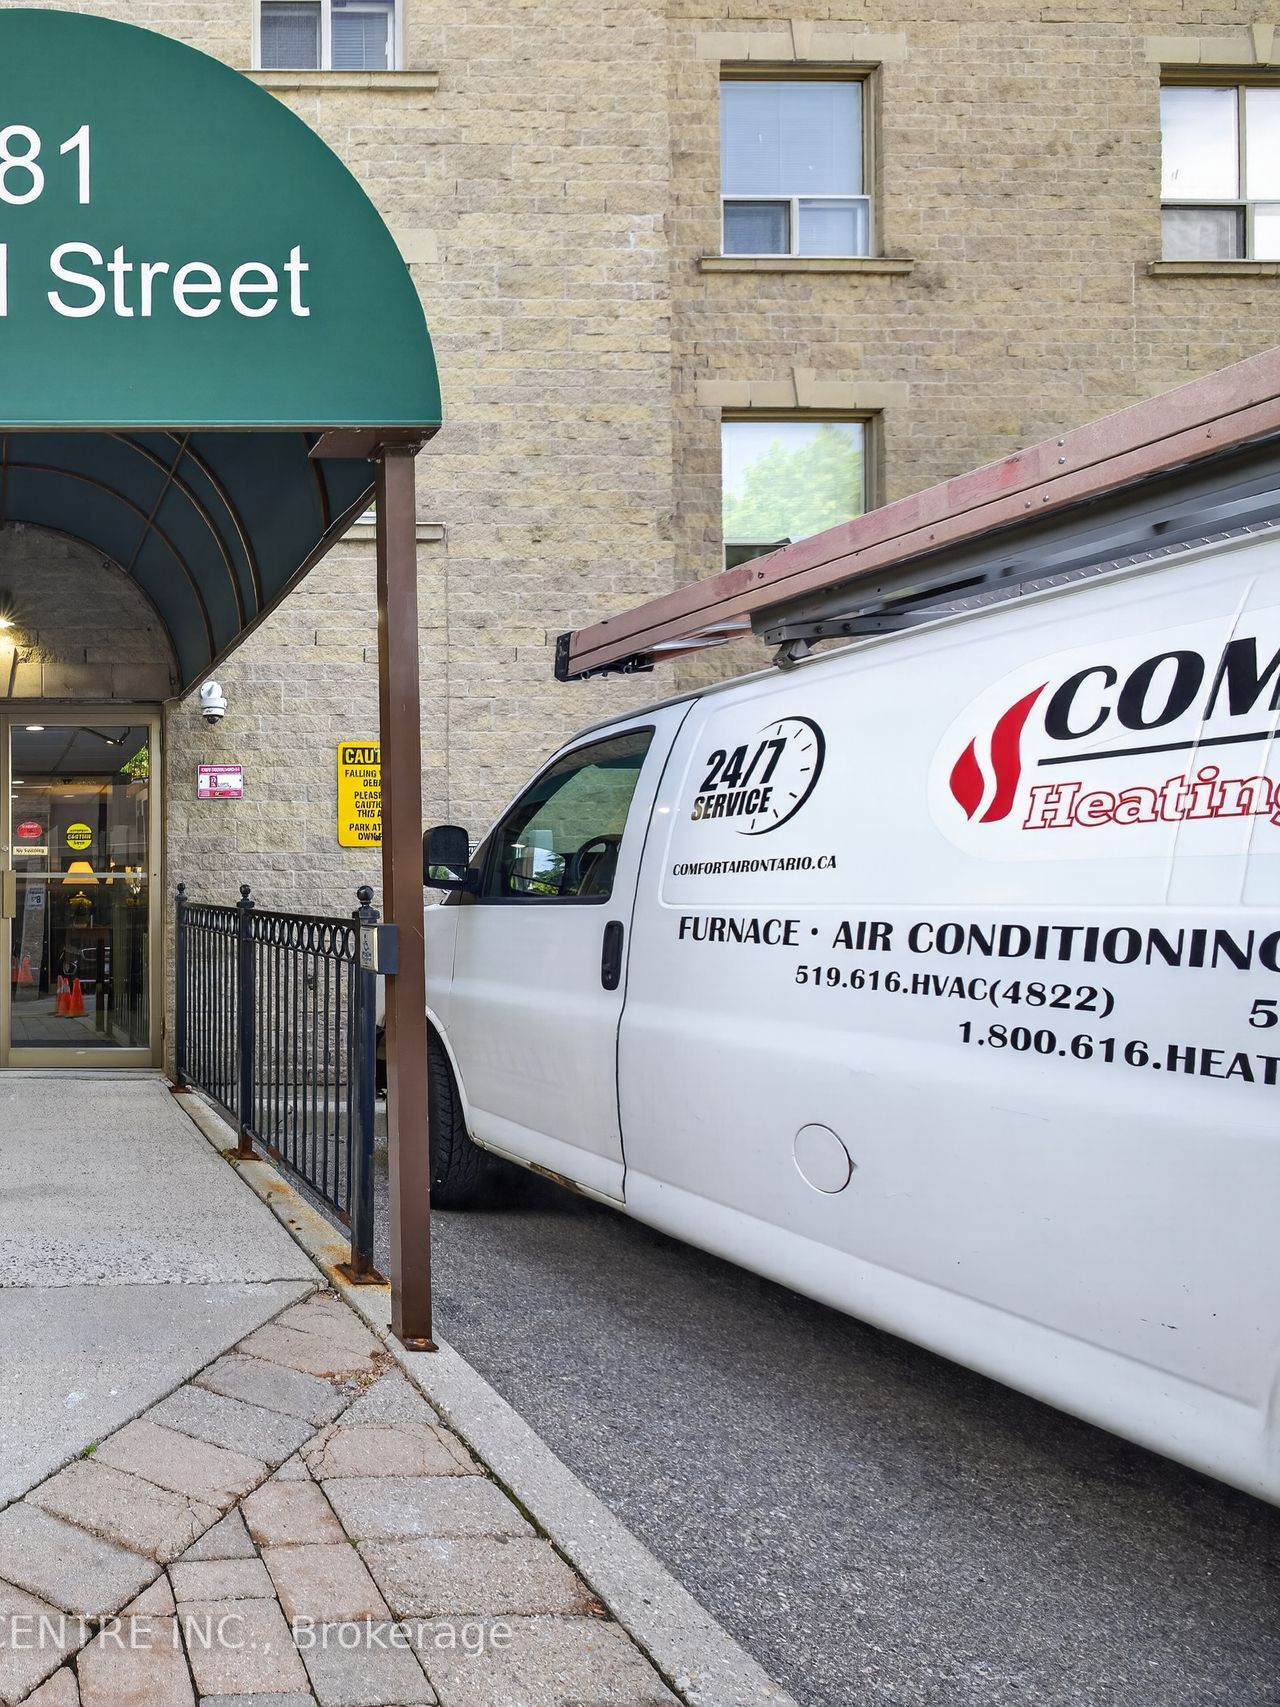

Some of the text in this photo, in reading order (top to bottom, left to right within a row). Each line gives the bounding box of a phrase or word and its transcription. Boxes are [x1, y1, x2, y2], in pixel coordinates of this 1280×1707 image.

[47, 241, 311, 318] Street
[345, 769, 377, 778] FALLING
[699, 737, 788, 793] 24/7
[357, 809, 375, 818] THIS
[691, 786, 773, 821] SERVICE
[1022, 765, 1280, 830] Heatin
[349, 823, 370, 831] PARK
[672, 855, 838, 876] COMFORTAIRONTARIO.CA
[678, 916, 801, 946] FURNACE
[832, 921, 894, 951] AIR
[795, 965, 1115, 1019] 519.616.HVAC(4822)
